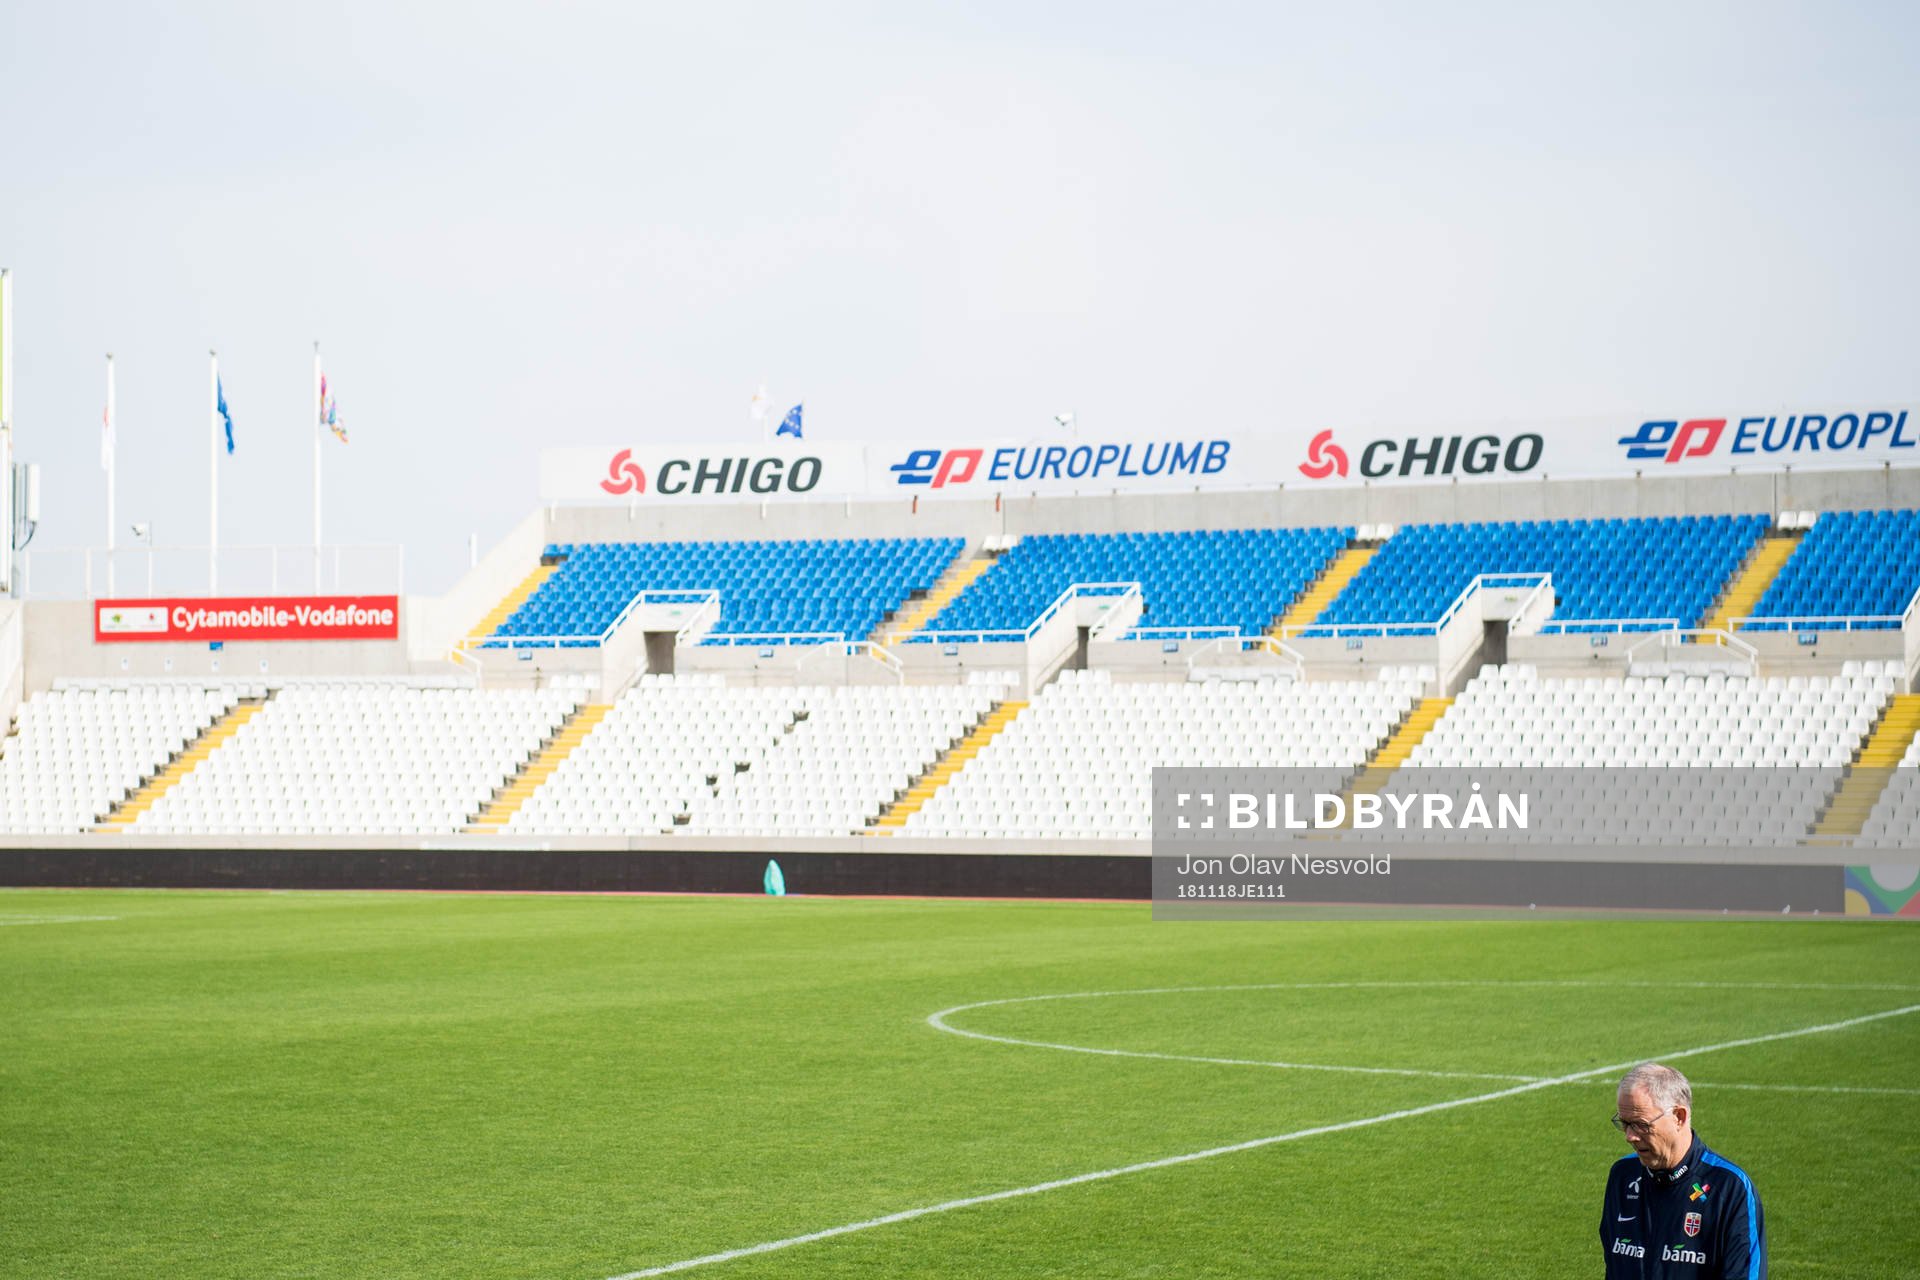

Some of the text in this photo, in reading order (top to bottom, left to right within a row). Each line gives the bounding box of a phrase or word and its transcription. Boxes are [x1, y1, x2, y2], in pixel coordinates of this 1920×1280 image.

[1731, 410, 1920, 454] EUROPL
[988, 440, 1230, 481] EUROPLUMB
[1359, 433, 1544, 477] CHIGO
[656, 457, 822, 495] CHIGO
[172, 605, 394, 632] Cytamobile-Vodafone
[1612, 1237, 1646, 1259] bama
[1661, 1244, 1706, 1265] bama
